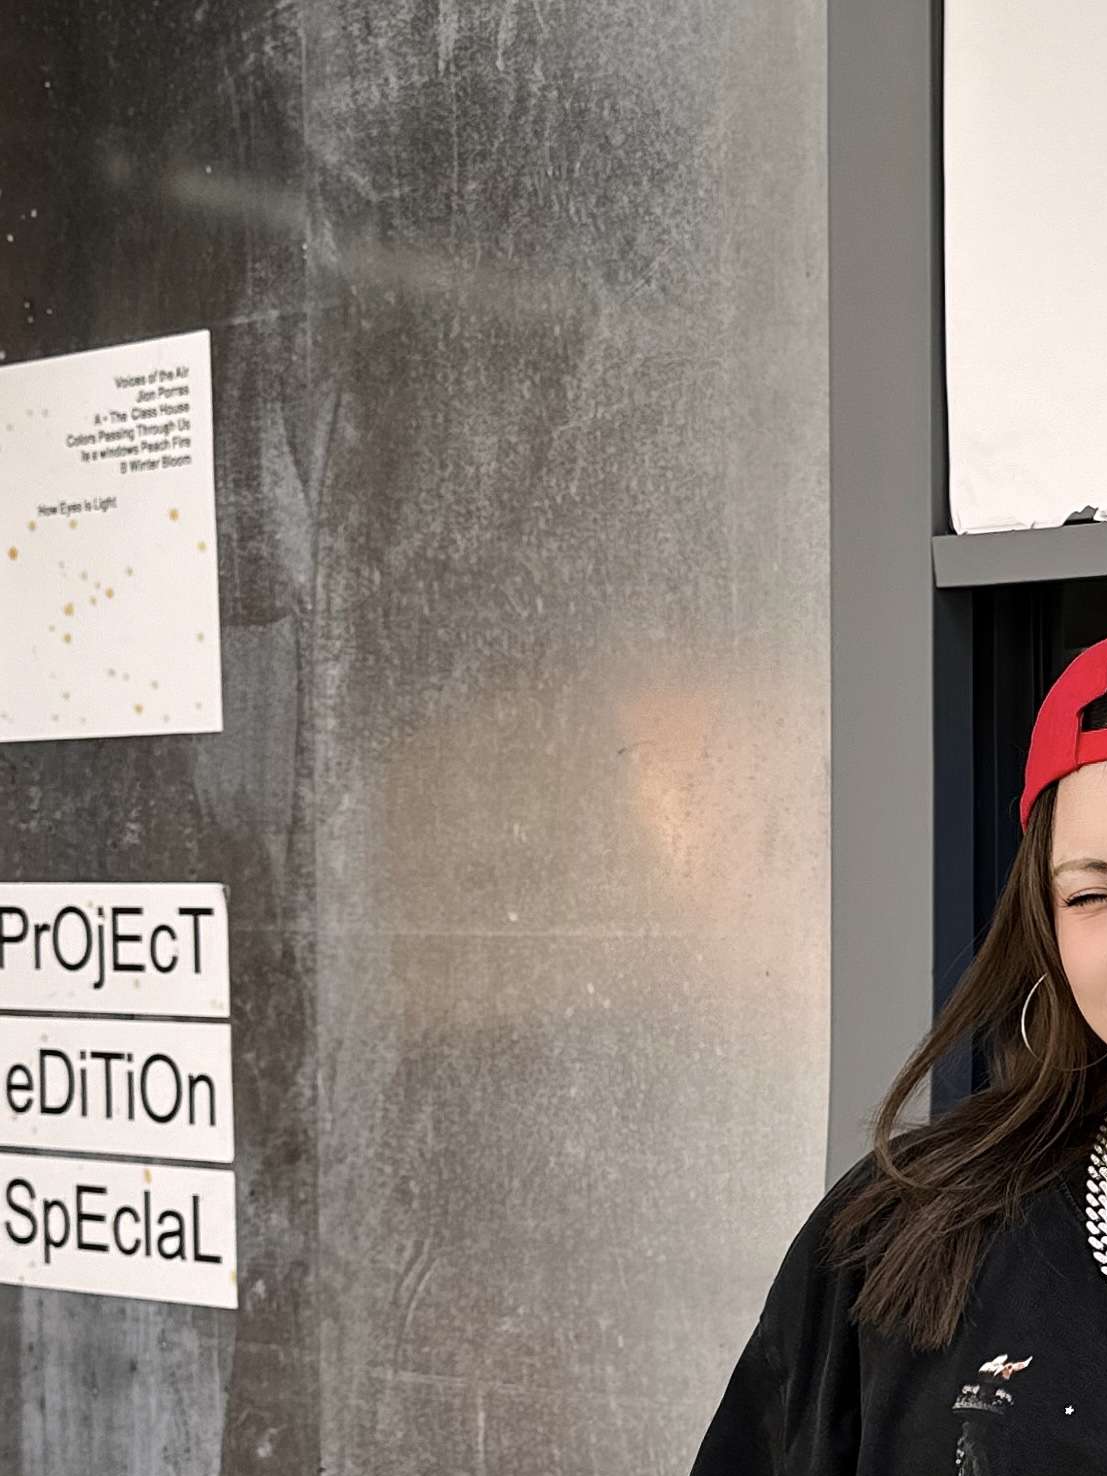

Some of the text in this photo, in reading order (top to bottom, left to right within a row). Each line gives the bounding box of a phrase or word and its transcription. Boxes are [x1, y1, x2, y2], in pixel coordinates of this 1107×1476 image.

[148, 369, 157, 384] of
[159, 368, 174, 383] the
[109, 410, 127, 424] The
[159, 402, 190, 417] House
[0, 905, 214, 990] PrOjEcT
[5, 1048, 217, 1127] eDiTiOn
